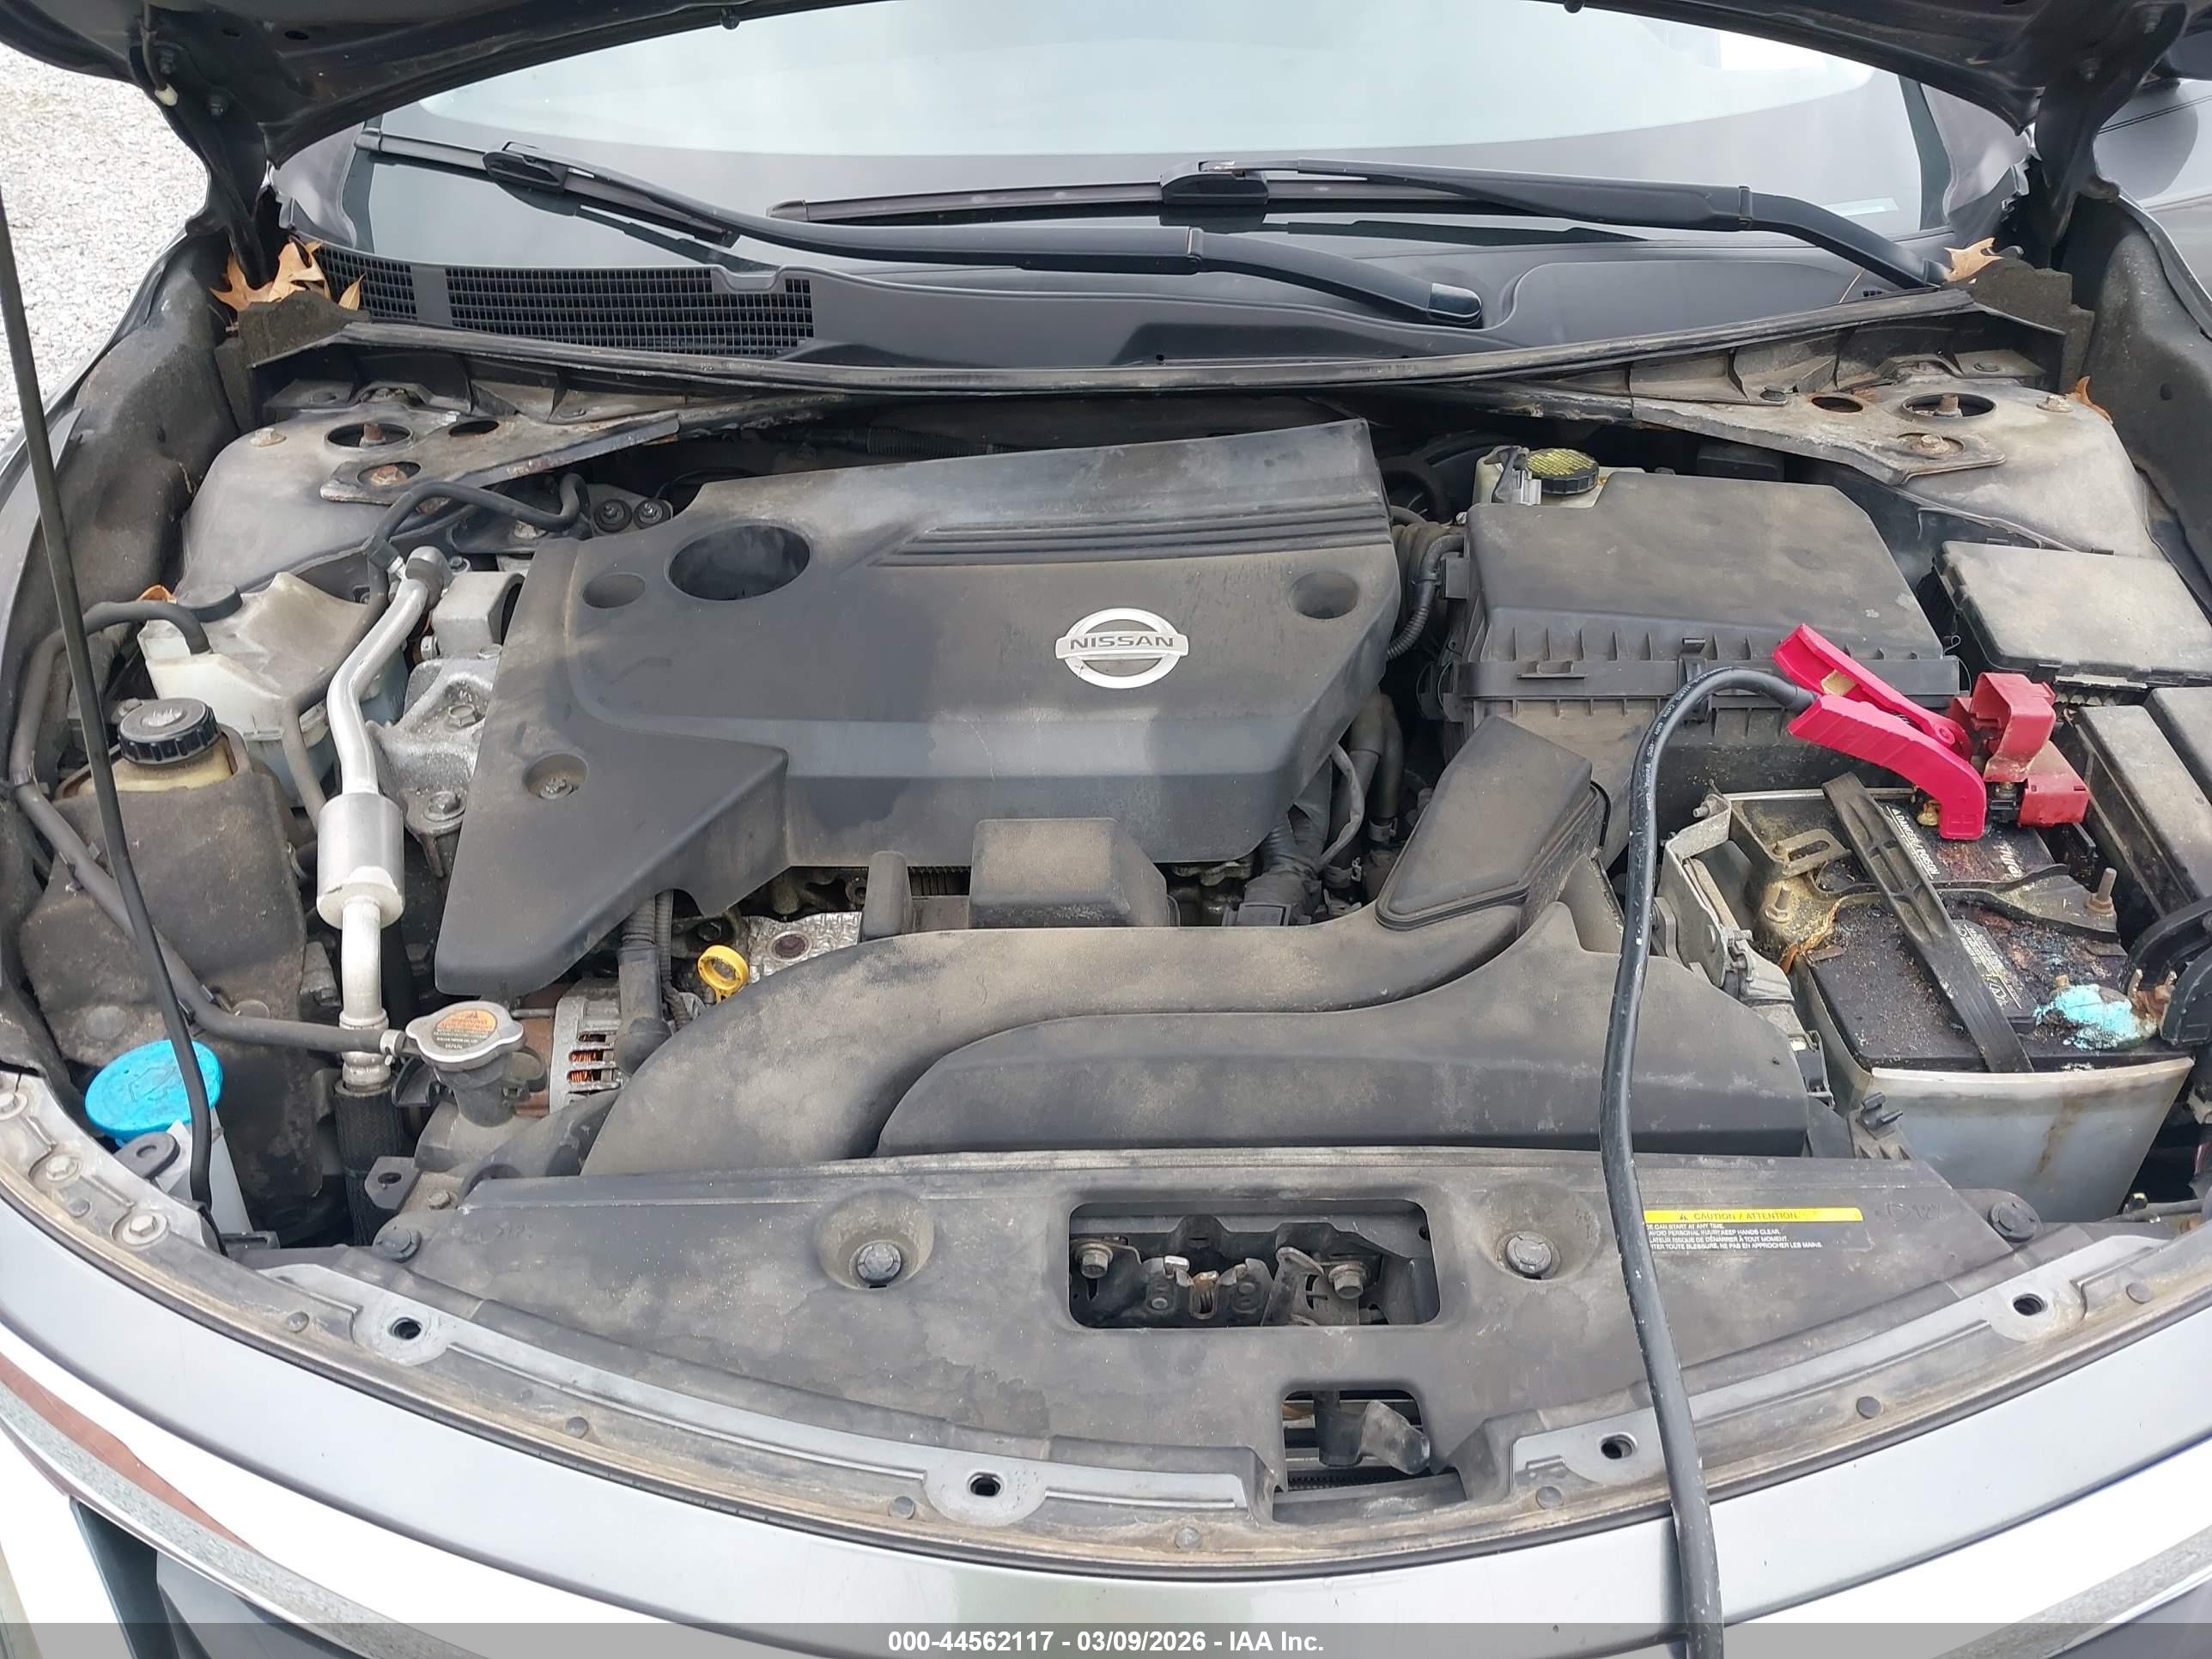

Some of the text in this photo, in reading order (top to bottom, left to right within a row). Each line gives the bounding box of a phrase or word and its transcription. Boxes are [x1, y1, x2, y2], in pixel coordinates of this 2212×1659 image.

[1070, 635, 1174, 650] NISSAN
[1895, 815, 1920, 845] DANGER
[1917, 848, 1941, 875] POISON
[1747, 1211, 1798, 1220] ATTENTION
